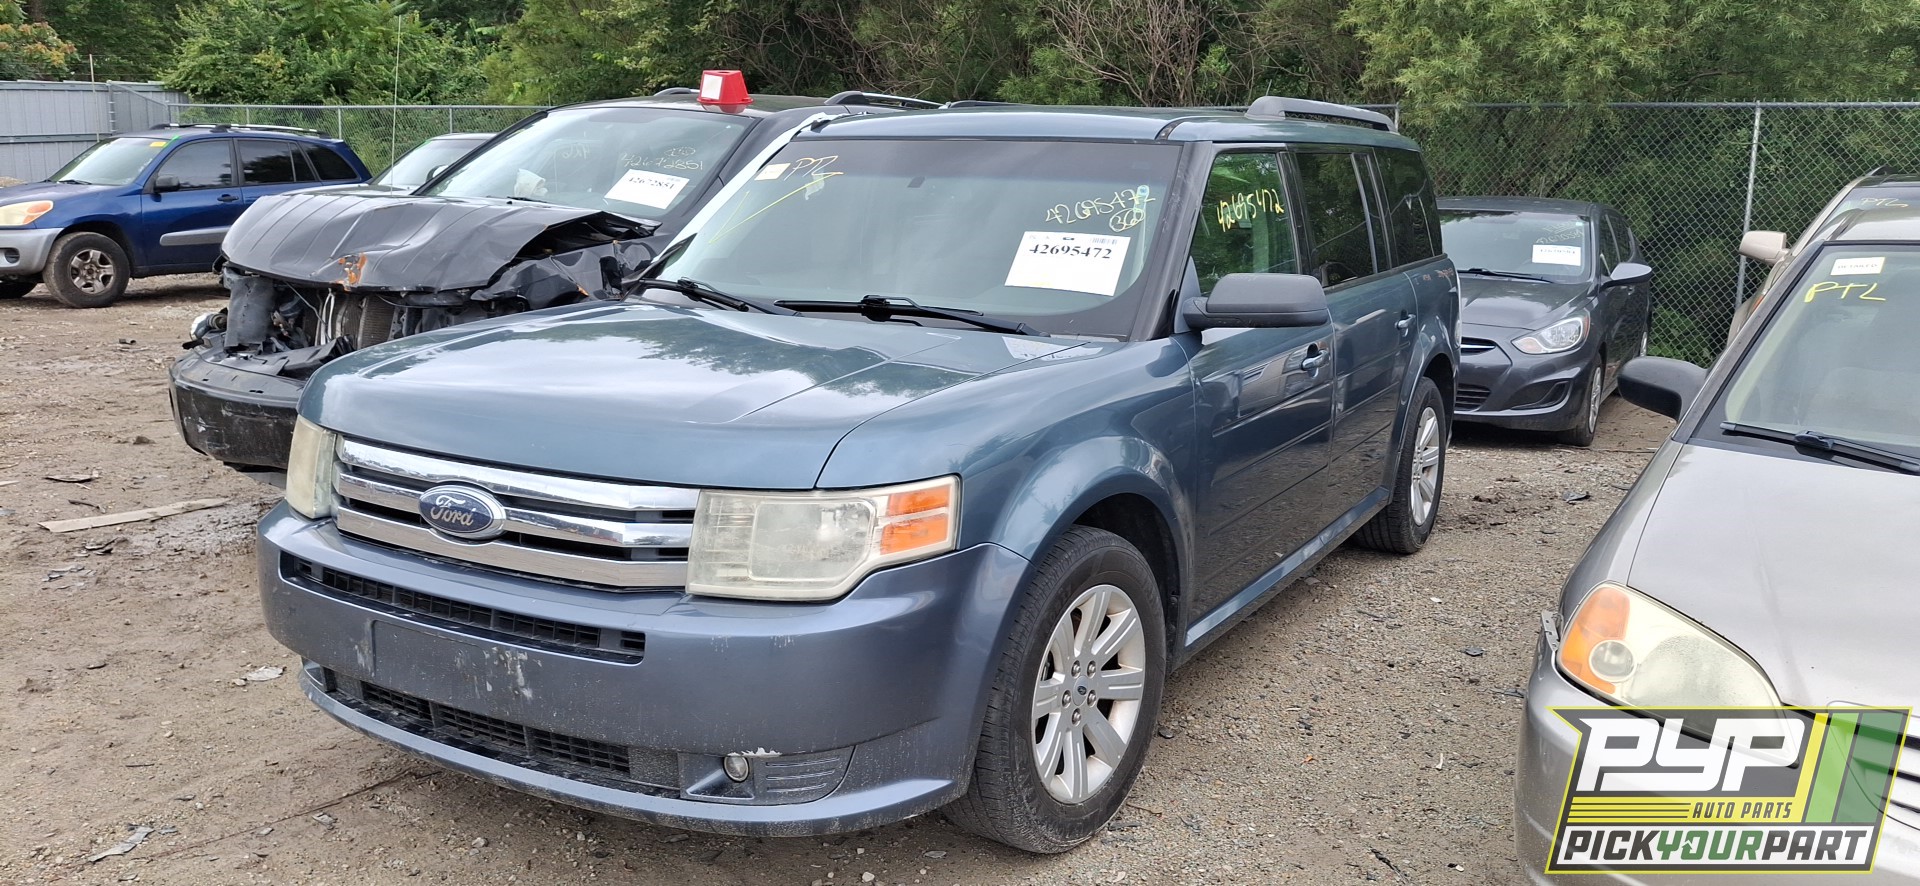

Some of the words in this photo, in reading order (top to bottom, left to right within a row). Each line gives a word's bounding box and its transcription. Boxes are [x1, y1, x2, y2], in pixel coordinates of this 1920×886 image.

[1216, 188, 1285, 233] 42695472
[1029, 243, 1113, 259] 42695472
[1804, 281, 1887, 302] PTL
[430, 494, 476, 527] Ford
